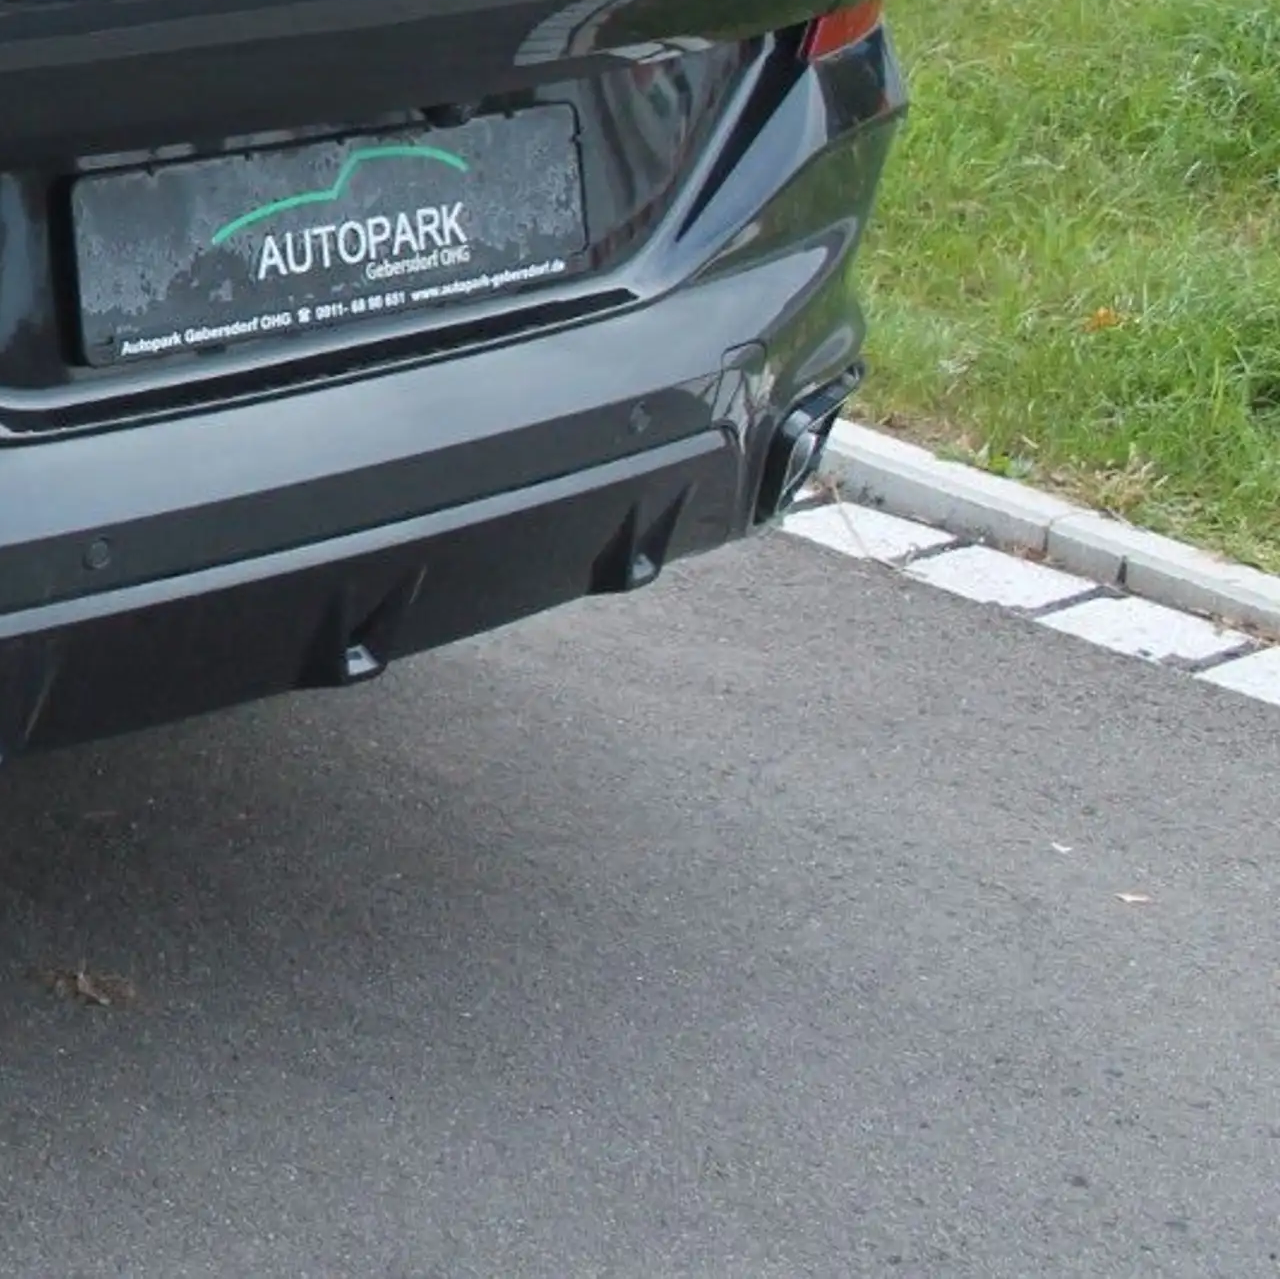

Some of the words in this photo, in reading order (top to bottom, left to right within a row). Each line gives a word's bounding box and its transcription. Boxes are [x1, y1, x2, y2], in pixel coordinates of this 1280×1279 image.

[258, 202, 468, 280] AUTOPARK
[366, 249, 440, 279] Gebersdorf
[440, 244, 472, 266] OHG
[121, 332, 182, 355] Autopark
[184, 317, 258, 343] Gebersdorf
[260, 312, 292, 329] OHG
